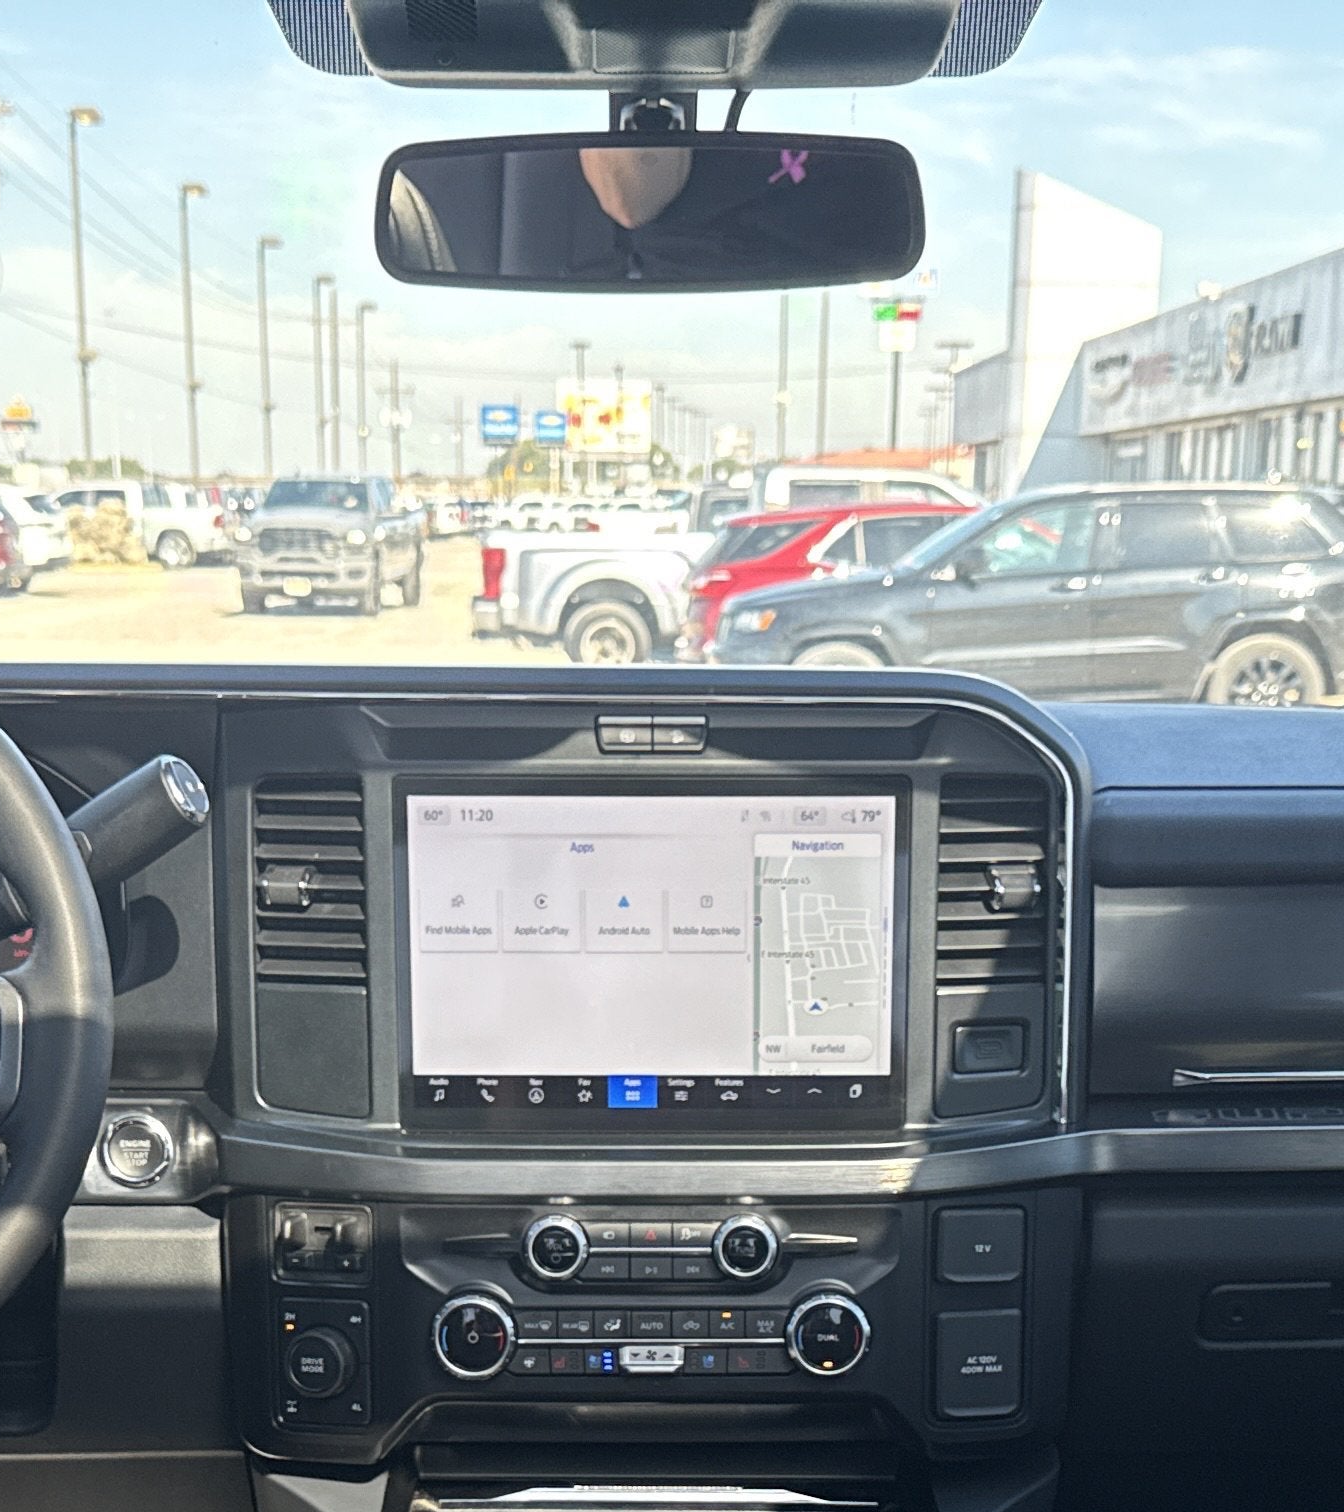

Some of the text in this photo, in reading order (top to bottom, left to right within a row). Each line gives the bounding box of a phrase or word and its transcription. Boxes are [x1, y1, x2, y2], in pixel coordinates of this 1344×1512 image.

[424, 810, 443, 822] 60°
[460, 809, 494, 822] 11:20
[800, 810, 819, 822] 64°
[861, 810, 882, 822] 79°
[570, 841, 594, 854] Apps
[792, 840, 844, 852] Navigation
[763, 877, 797, 885] Interstate
[425, 926, 492, 936] Find Mobile Apps
[515, 926, 569, 936] Apple CarPlay
[598, 926, 650, 935] Android Auto
[673, 926, 741, 936] Mobile Apps Help
[765, 1044, 782, 1053] NW
[811, 1044, 845, 1053] Fairfield
[429, 1078, 449, 1086] Audio
[476, 1078, 499, 1086] Phone
[529, 1078, 543, 1086] Nav
[578, 1078, 591, 1086] Fav
[624, 1078, 641, 1087] Apps
[667, 1078, 695, 1087] Settings
[714, 1078, 744, 1086] Features
[119, 1140, 151, 1148] ENGINE
[123, 1152, 149, 1160] START
[284, 1313, 295, 1321] 2H
[350, 1316, 362, 1324] 4H
[640, 1322, 664, 1330] AUTO
[720, 1322, 735, 1330] A/C
[757, 1319, 774, 1327] MAX
[817, 1333, 840, 1341] DUAL
[301, 1357, 324, 1365] DRIVE
[966, 1356, 977, 1364] AC
[301, 1365, 324, 1373] MODE
[960, 1364, 1002, 1374] 400W MAX
[351, 1403, 362, 1411] 4L
